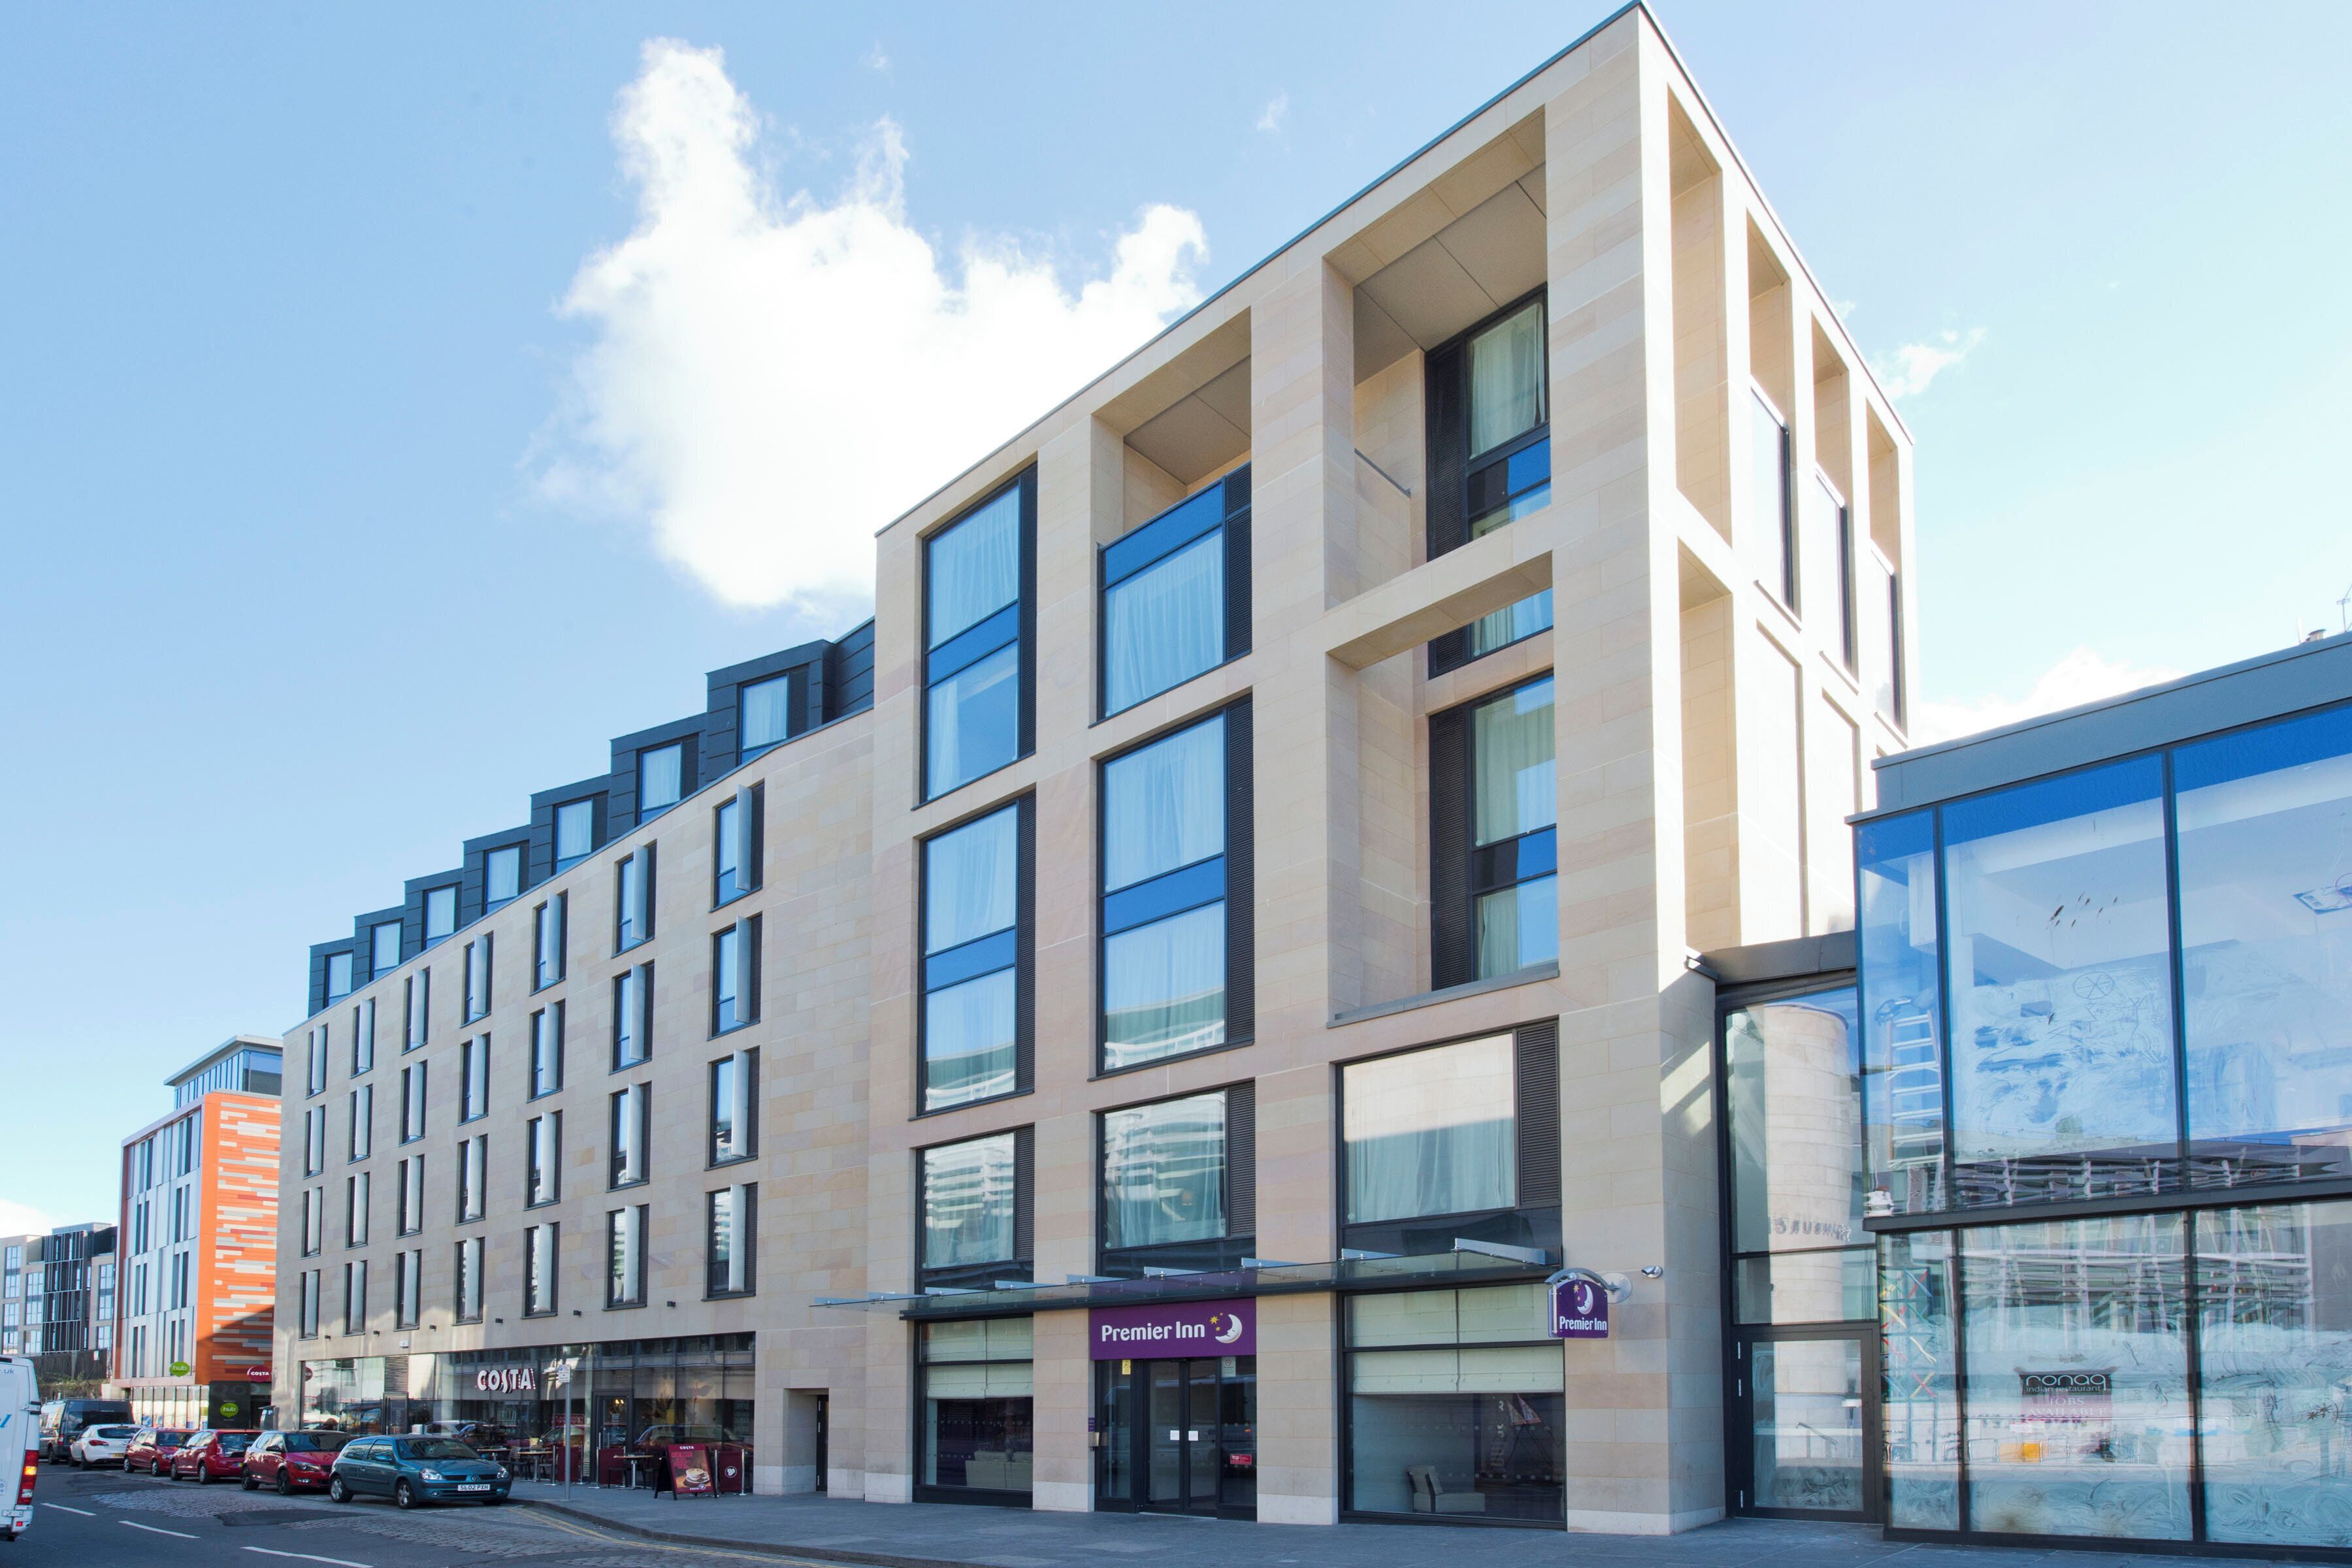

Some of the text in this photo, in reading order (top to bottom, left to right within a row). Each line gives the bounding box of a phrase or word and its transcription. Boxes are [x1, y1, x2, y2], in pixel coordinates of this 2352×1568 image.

[1102, 1321, 1205, 1342] Premier Inn
[1560, 1316, 1607, 1331] Premier Inn
[477, 1369, 536, 1394] COSTA
[2026, 1374, 2106, 1391] ronaq
[2050, 1397, 2085, 1406] JOBS
[2028, 1408, 2108, 1416] AVAILABLE
